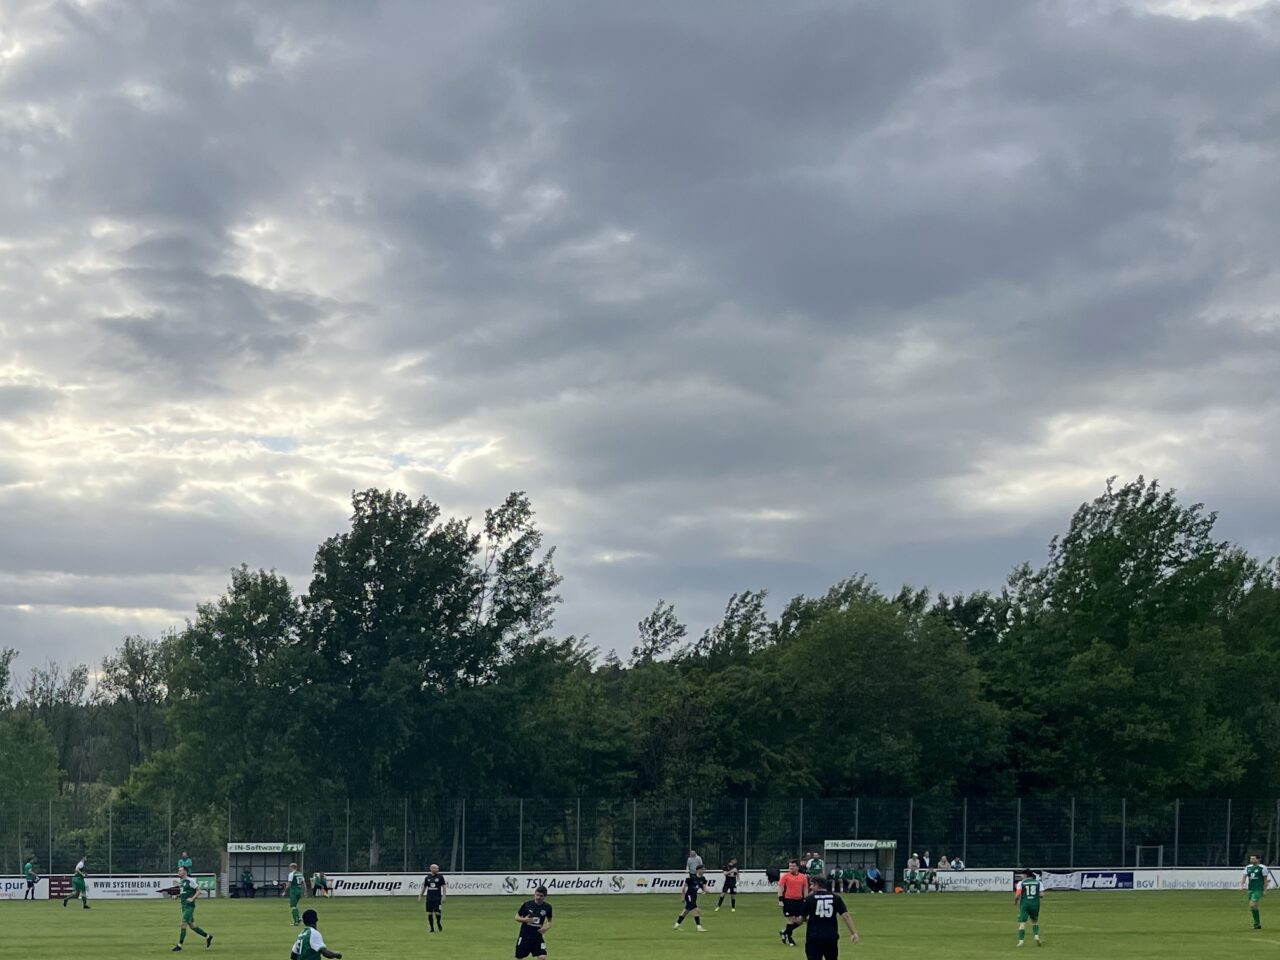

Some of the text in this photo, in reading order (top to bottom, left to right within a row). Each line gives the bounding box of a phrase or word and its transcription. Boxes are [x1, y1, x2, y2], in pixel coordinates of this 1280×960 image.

[5, 882, 24, 891] pur
[334, 879, 402, 891] Pneuhage
[526, 877, 603, 889] TSV Auerbach
[1136, 880, 1154, 889] BGV
[1025, 885, 1037, 896] 18
[815, 899, 834, 918] 45
